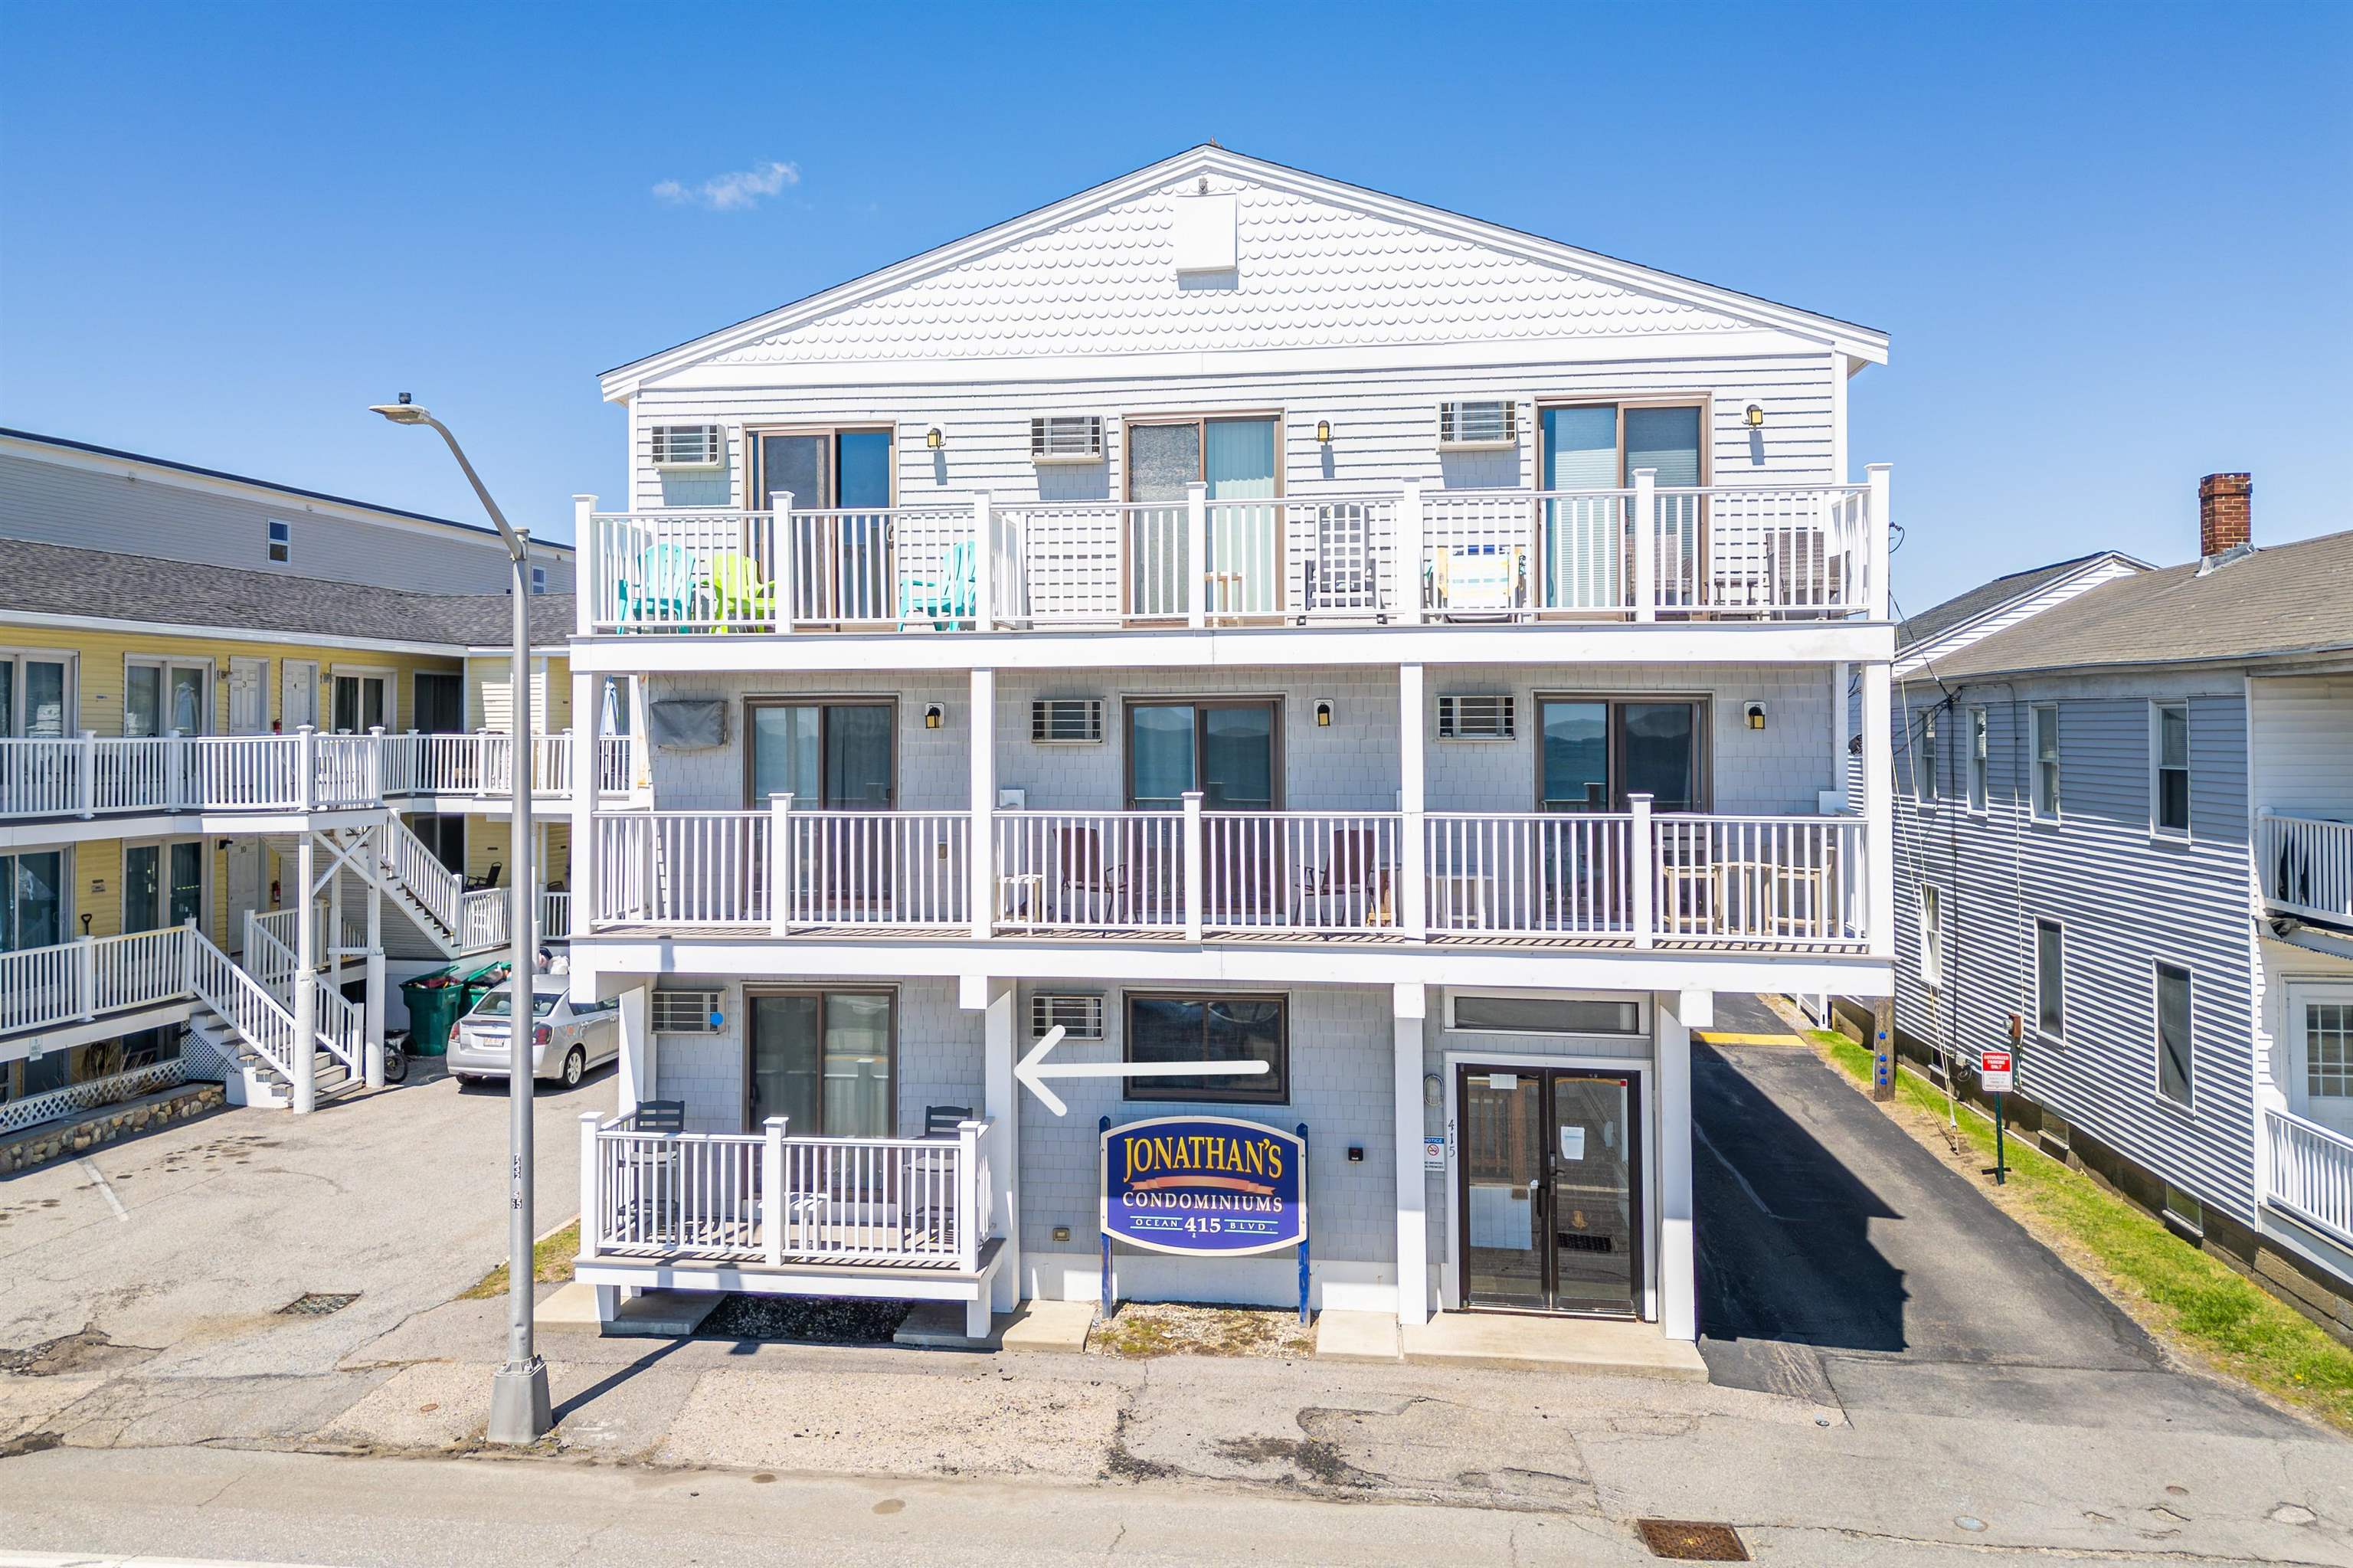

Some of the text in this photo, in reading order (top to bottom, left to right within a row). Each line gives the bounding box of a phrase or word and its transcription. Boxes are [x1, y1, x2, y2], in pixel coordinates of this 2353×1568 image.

[1123, 1136, 1282, 1183] JONATHAN'S
[1122, 1192, 1283, 1213] CONDOMINIUMS
[1135, 1216, 1273, 1233] OCEAN 415 BLVD.
